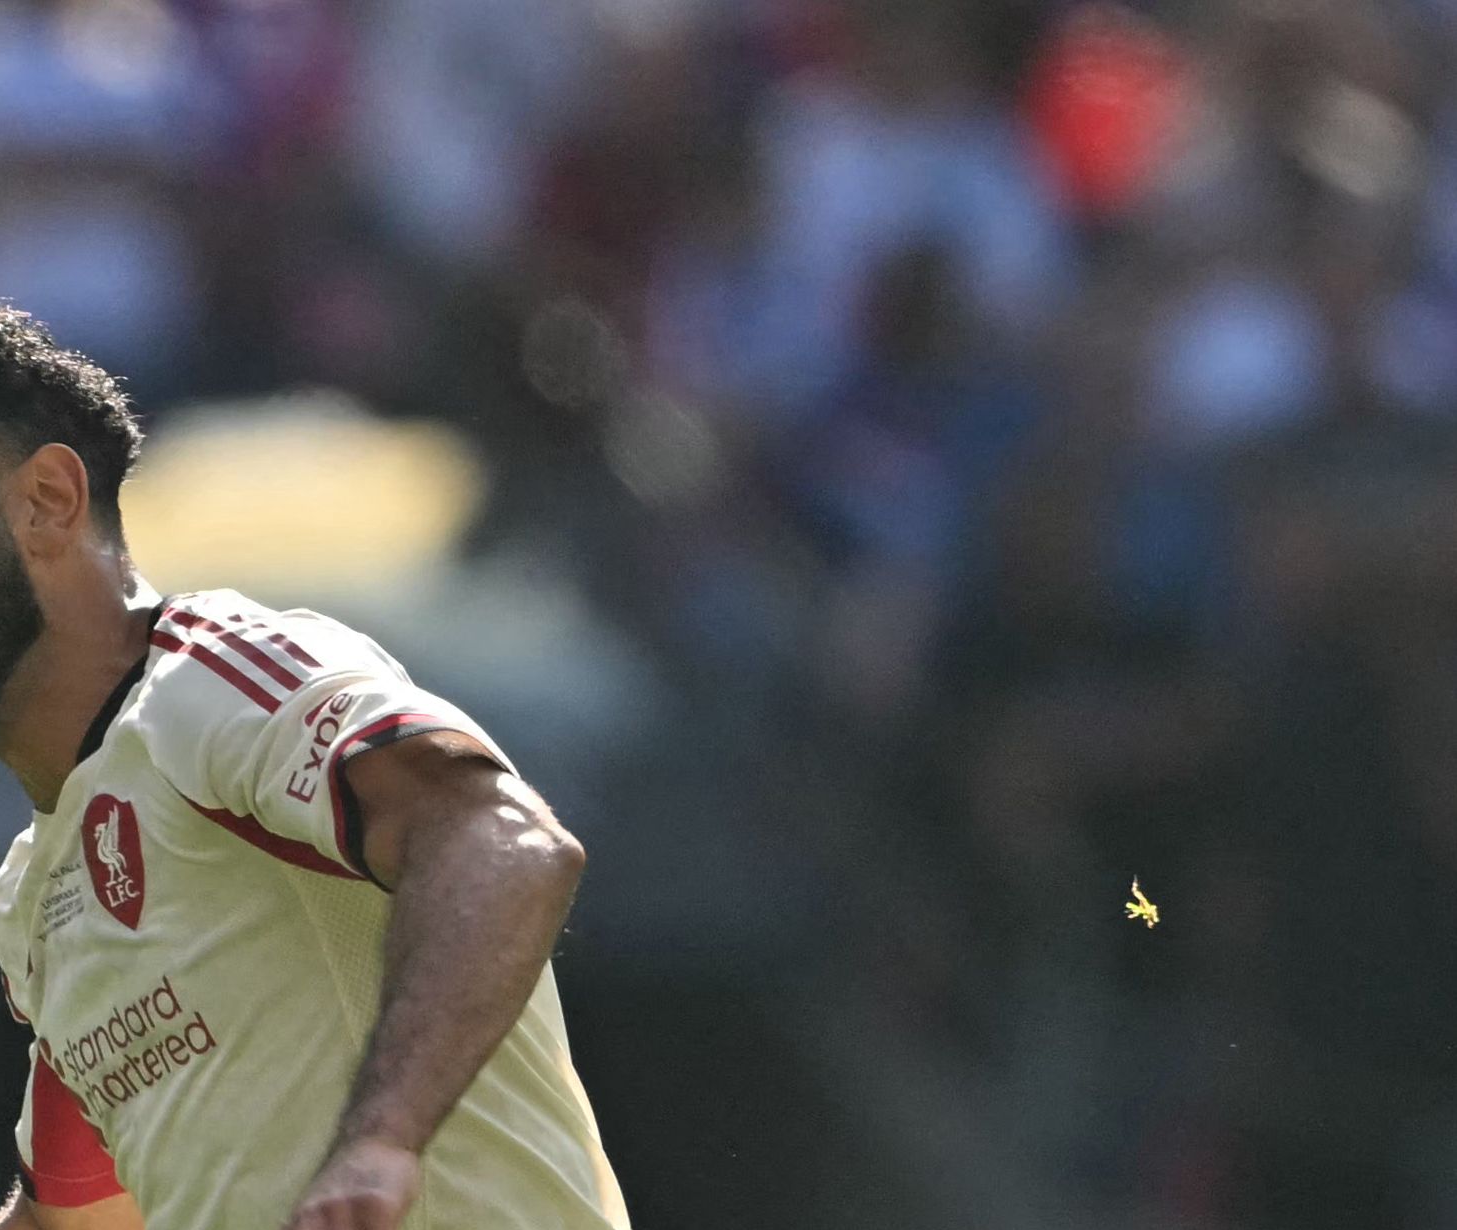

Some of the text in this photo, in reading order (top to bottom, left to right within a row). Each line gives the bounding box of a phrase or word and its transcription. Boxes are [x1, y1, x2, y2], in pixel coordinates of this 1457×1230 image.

[106, 879, 140, 907] LFC
[64, 975, 183, 1083] standard
[82, 1011, 217, 1120] hartered
